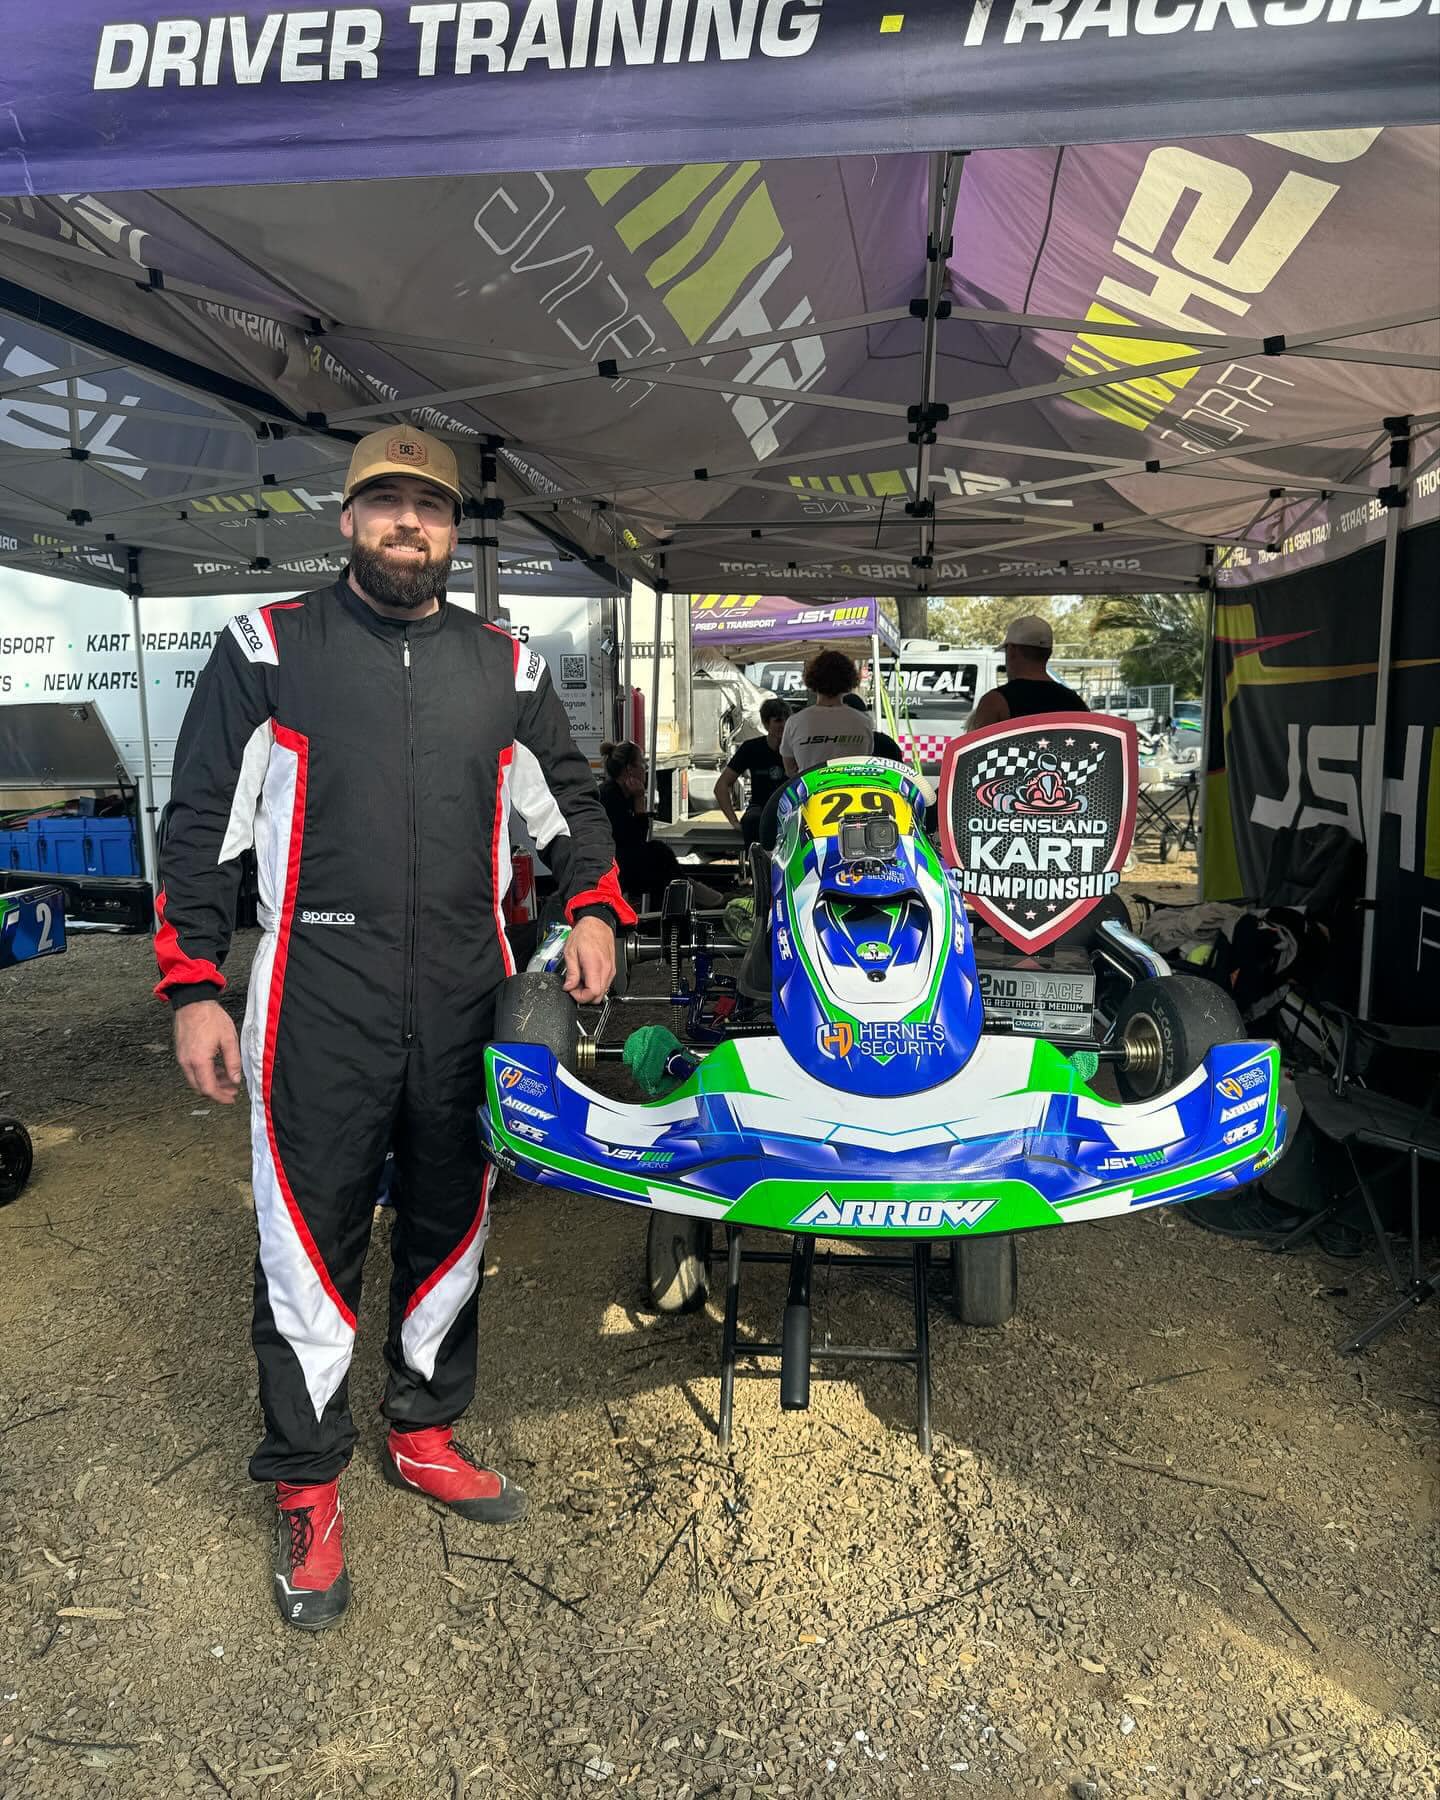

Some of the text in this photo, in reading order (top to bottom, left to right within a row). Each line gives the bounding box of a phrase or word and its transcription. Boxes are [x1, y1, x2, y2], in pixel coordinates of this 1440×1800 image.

[93, 8, 383, 90] DRIVER
[408, 0, 823, 76] TRAINING
[695, 622, 718, 631] PREP
[726, 619, 776, 629] TRANSPORT
[787, 610, 834, 625] JSH
[87, 633, 131, 652] KART
[235, 614, 263, 652] sparco
[44, 673, 83, 691] NEW
[87, 671, 138, 690] KARTS
[1250, 724, 1424, 872] JSH
[821, 792, 896, 825] 29
[968, 818, 1108, 834] QUEENSLAND
[970, 836, 1105, 872] KART
[951, 868, 1121, 900] CHAMPIONSHIP
[301, 911, 356, 924] sparco
[36, 902, 53, 953] 2
[980, 974, 1084, 1001] 2ND PLACE
[994, 999, 1046, 1009] RESTRICTED
[1049, 1002, 1084, 1012] MEDIUM
[859, 1024, 945, 1041] HERNE'S
[860, 1041, 945, 1056] SECURITY
[501, 1095, 559, 1121] ARROW
[602, 1147, 645, 1161] JSH
[1097, 1157, 1136, 1170] JSH
[636, 1161, 669, 1169] RACING
[790, 1191, 1000, 1229] ARROW
